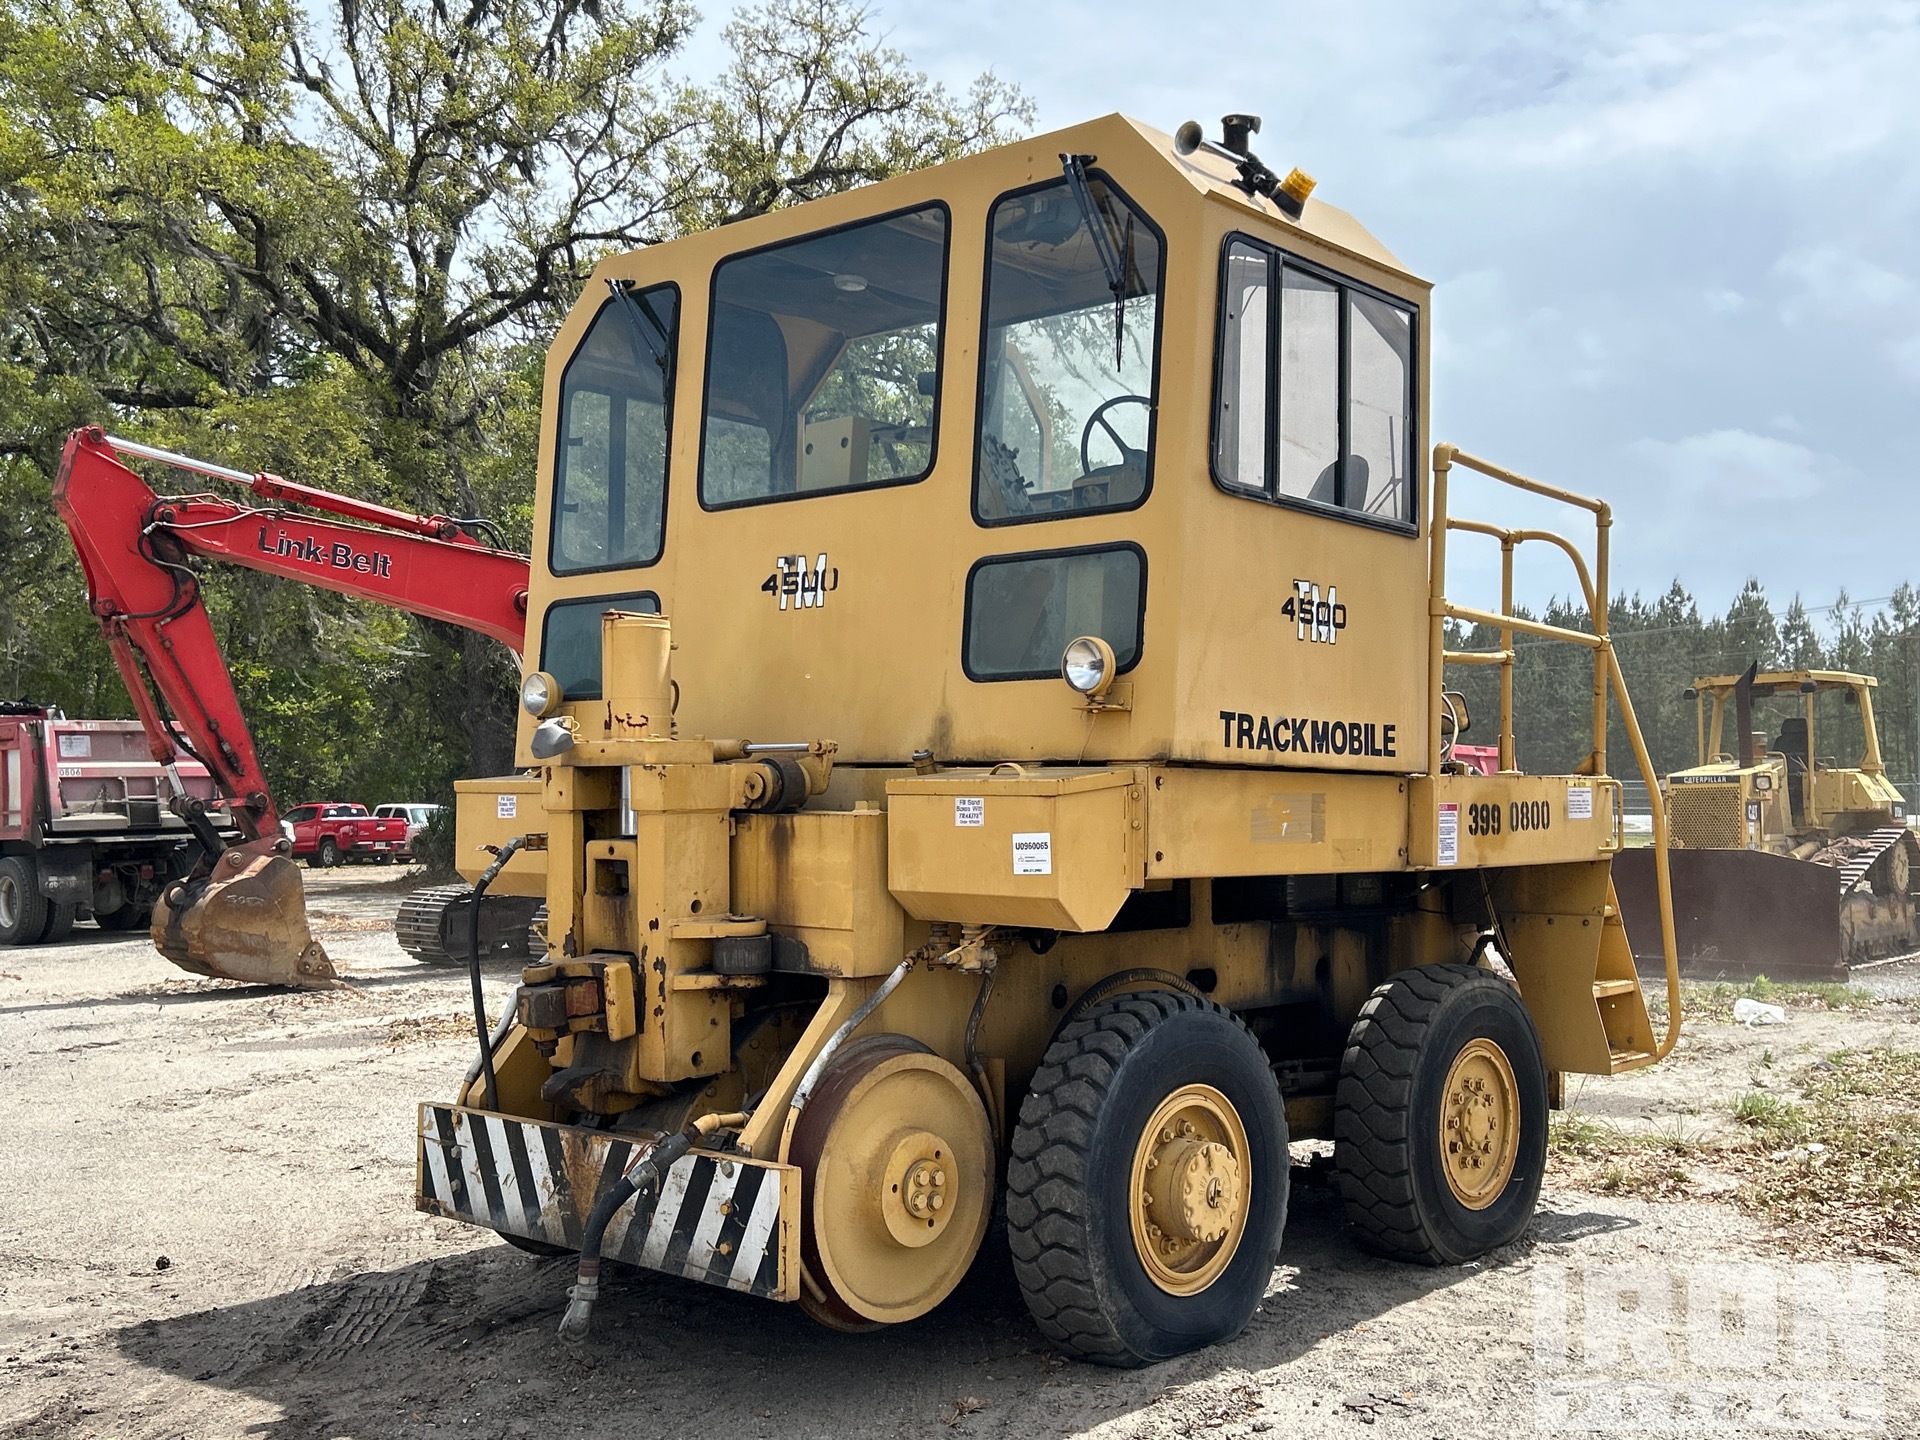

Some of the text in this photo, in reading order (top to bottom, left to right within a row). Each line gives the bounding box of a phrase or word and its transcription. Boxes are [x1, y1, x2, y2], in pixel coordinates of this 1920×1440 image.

[257, 525, 393, 579] Link-Belt
[1281, 596, 1347, 629] 4500
[1219, 710, 1397, 758] TRACKMOBILE
[1683, 775, 1728, 784] CATERPILLAR
[1468, 802, 1501, 836] 399
[1508, 800, 1551, 833] 0800
[1015, 841, 1049, 851] U0960065
